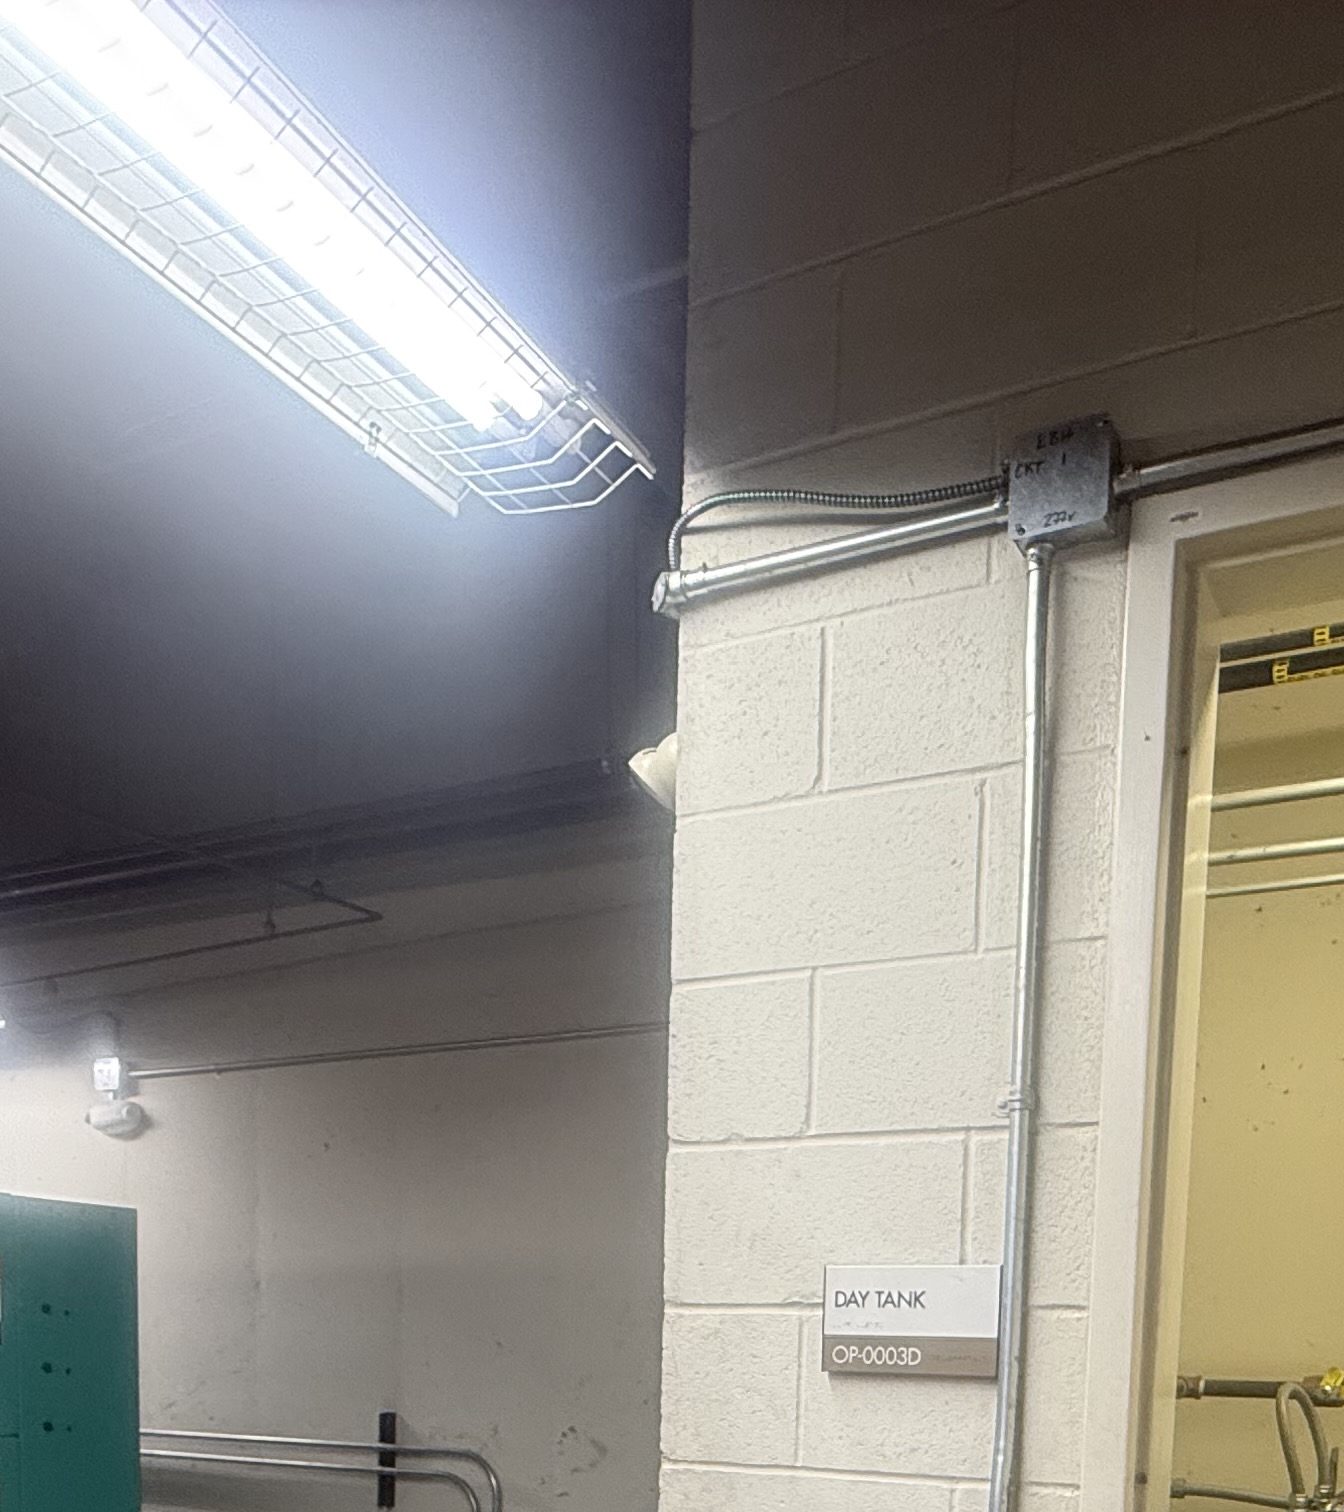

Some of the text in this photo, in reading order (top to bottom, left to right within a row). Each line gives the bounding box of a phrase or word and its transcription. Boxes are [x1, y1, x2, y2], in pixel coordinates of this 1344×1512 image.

[834, 1290, 926, 1309] DAY TANK
[832, 1345, 922, 1366] OP-0003D
